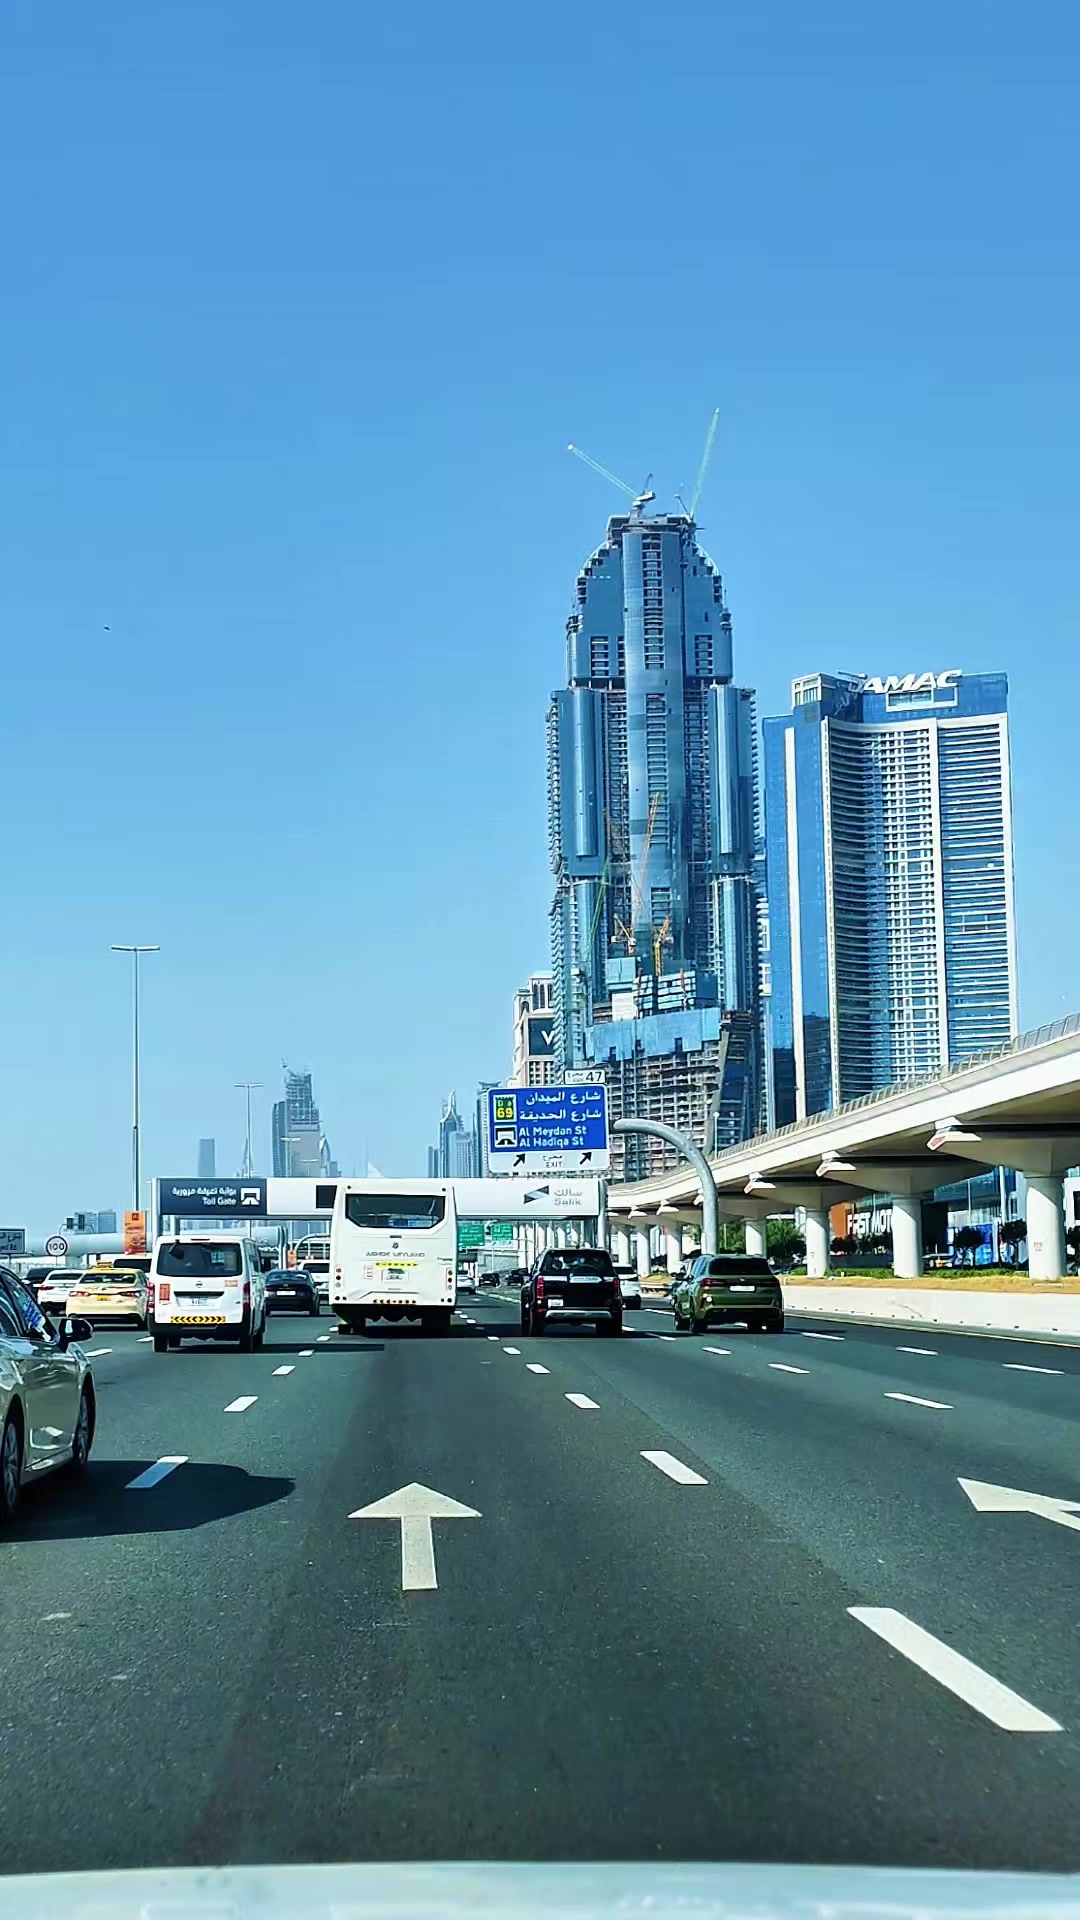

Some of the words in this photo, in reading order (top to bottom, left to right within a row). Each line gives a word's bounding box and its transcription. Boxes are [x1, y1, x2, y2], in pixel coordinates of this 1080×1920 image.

[585, 1071, 602, 1082] 47
[525, 1091, 565, 1105] الميدان
[570, 1091, 601, 1105] شارع
[497, 1107, 513, 1118] 69
[519, 1109, 567, 1122] الحديقة
[570, 1109, 602, 1122] شارع
[518, 1127, 530, 1137] Al
[533, 1126, 572, 1138] Meydan
[574, 1125, 587, 1136] St
[519, 1138, 530, 1147] Al
[533, 1137, 569, 1148] Hadiqa
[572, 1136, 584, 1146] St
[172, 1187, 196, 1197] مرورية
[197, 1187, 218, 1197] تعرفة
[554, 1188, 583, 1197] سالك
[202, 1197, 216, 1206] Toll
[217, 1197, 237, 1206] Gate
[554, 1198, 582, 1206] Salik
[871, 1209, 893, 1234] MOT
[49, 1241, 65, 1251] 100
